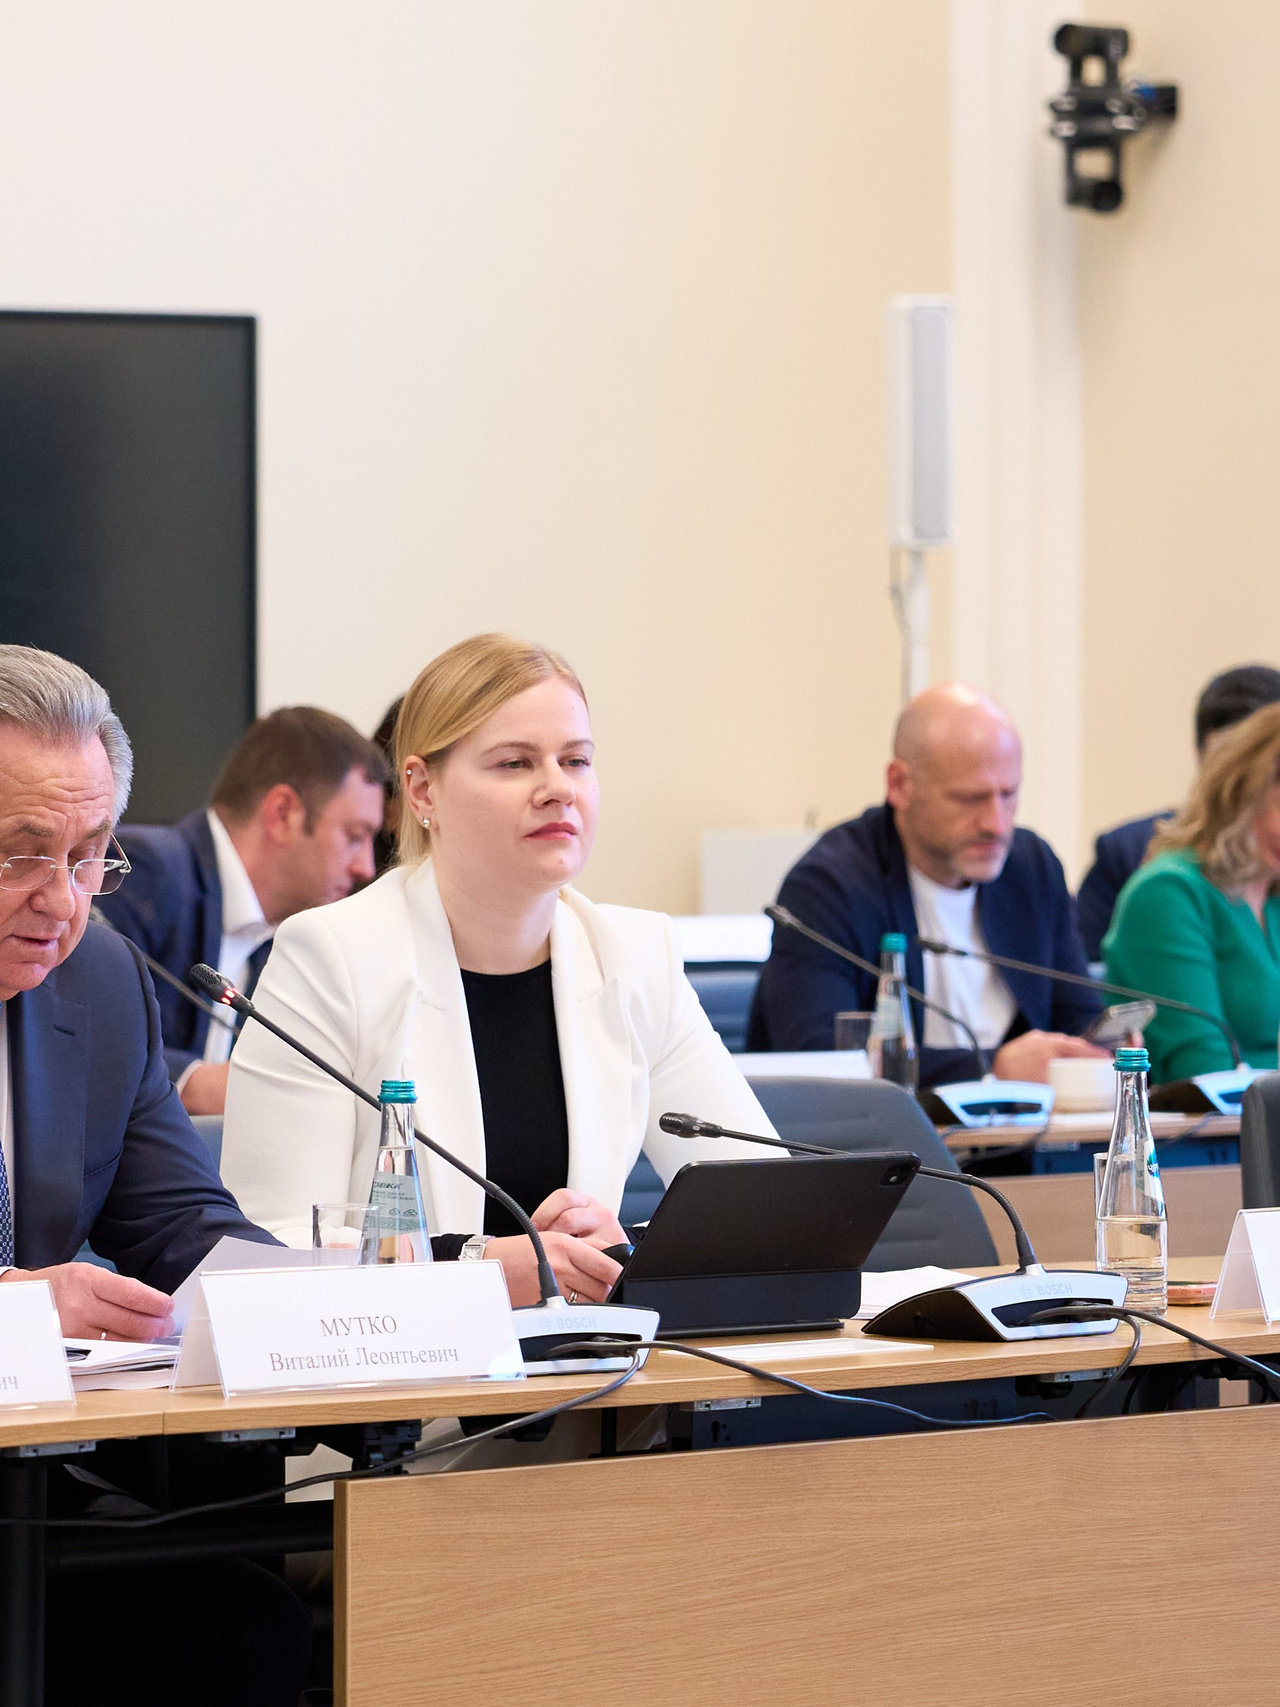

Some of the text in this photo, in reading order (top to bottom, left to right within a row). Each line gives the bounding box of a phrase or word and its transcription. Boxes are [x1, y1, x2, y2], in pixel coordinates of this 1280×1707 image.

[1036, 1283, 1073, 1296] BOSCH
[319, 1314, 398, 1338] МУТКО
[557, 1316, 597, 1330] BOSCH
[269, 1346, 459, 1372] Виталий Леонтьевич
